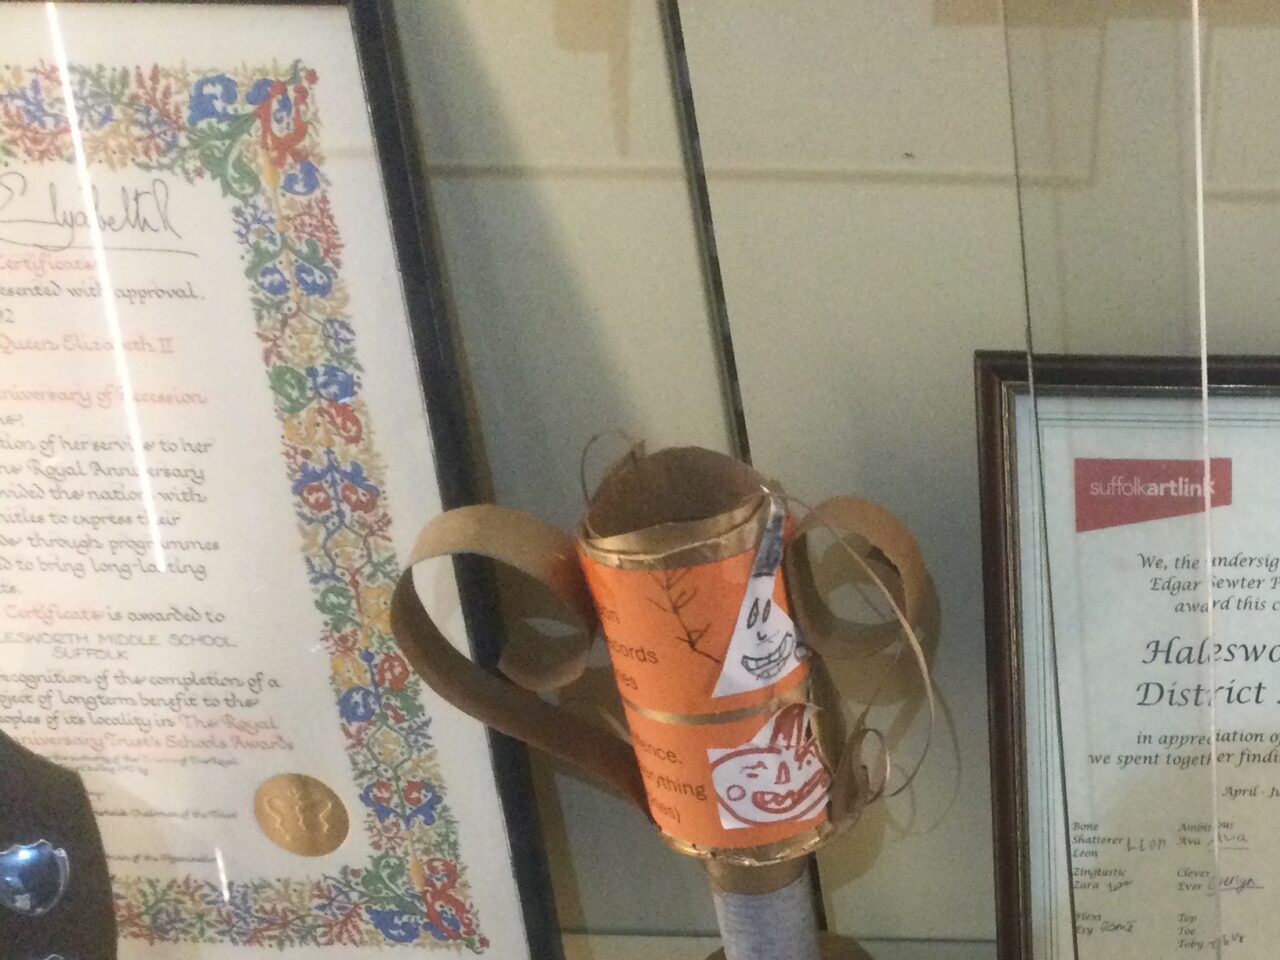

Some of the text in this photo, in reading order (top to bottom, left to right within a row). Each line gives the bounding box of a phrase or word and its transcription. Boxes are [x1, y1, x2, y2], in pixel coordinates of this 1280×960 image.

[62, 332, 155, 353] Elizaeth
[158, 336, 173, 354] II
[40, 433, 55, 458] of
[58, 434, 88, 450] her
[92, 435, 156, 452] servie
[159, 438, 178, 452] to
[180, 437, 213, 453] her
[26, 458, 205, 485] Royal Anniersary
[48, 484, 206, 502] the with
[49, 509, 180, 530] to express teir
[28, 533, 103, 556] through
[16, 560, 34, 571] to
[37, 556, 85, 579] bring
[89, 557, 206, 581] long-lating
[1138, 553, 1168, 571] We,
[1175, 554, 1200, 570] the
[1150, 576, 1202, 596] Edgar
[1174, 596, 1234, 613] award
[1236, 596, 1266, 611] this
[5, 603, 225, 627] Certificate is awarded to
[97, 633, 160, 646] MIDDLE
[168, 633, 237, 648] SCHOOL
[52, 646, 128, 660] SUFFOLK
[94, 669, 109, 691] of
[112, 669, 147, 685] the
[149, 670, 245, 692] completion
[247, 672, 263, 694] of
[267, 678, 282, 688] a
[38, 689, 260, 714] of benefit to the
[1135, 679, 1267, 707] District
[46, 710, 60, 731] of
[64, 713, 85, 726] its
[86, 711, 152, 733] locality
[221, 714, 279, 736] Royal
[1137, 732, 1152, 745] in
[1158, 730, 1264, 749] appreciation
[1089, 754, 1111, 765] we
[1116, 753, 1160, 770] spent
[1221, 784, 1258, 800] April
[1072, 822, 1099, 831] Bone
[1177, 822, 1234, 832] Ambitous
[1072, 836, 1123, 846] Shatterer
[1177, 837, 1201, 846] Ava
[1072, 850, 1098, 858] Leon
[1177, 870, 1210, 879] Clever
[1177, 884, 1202, 892] Ever
